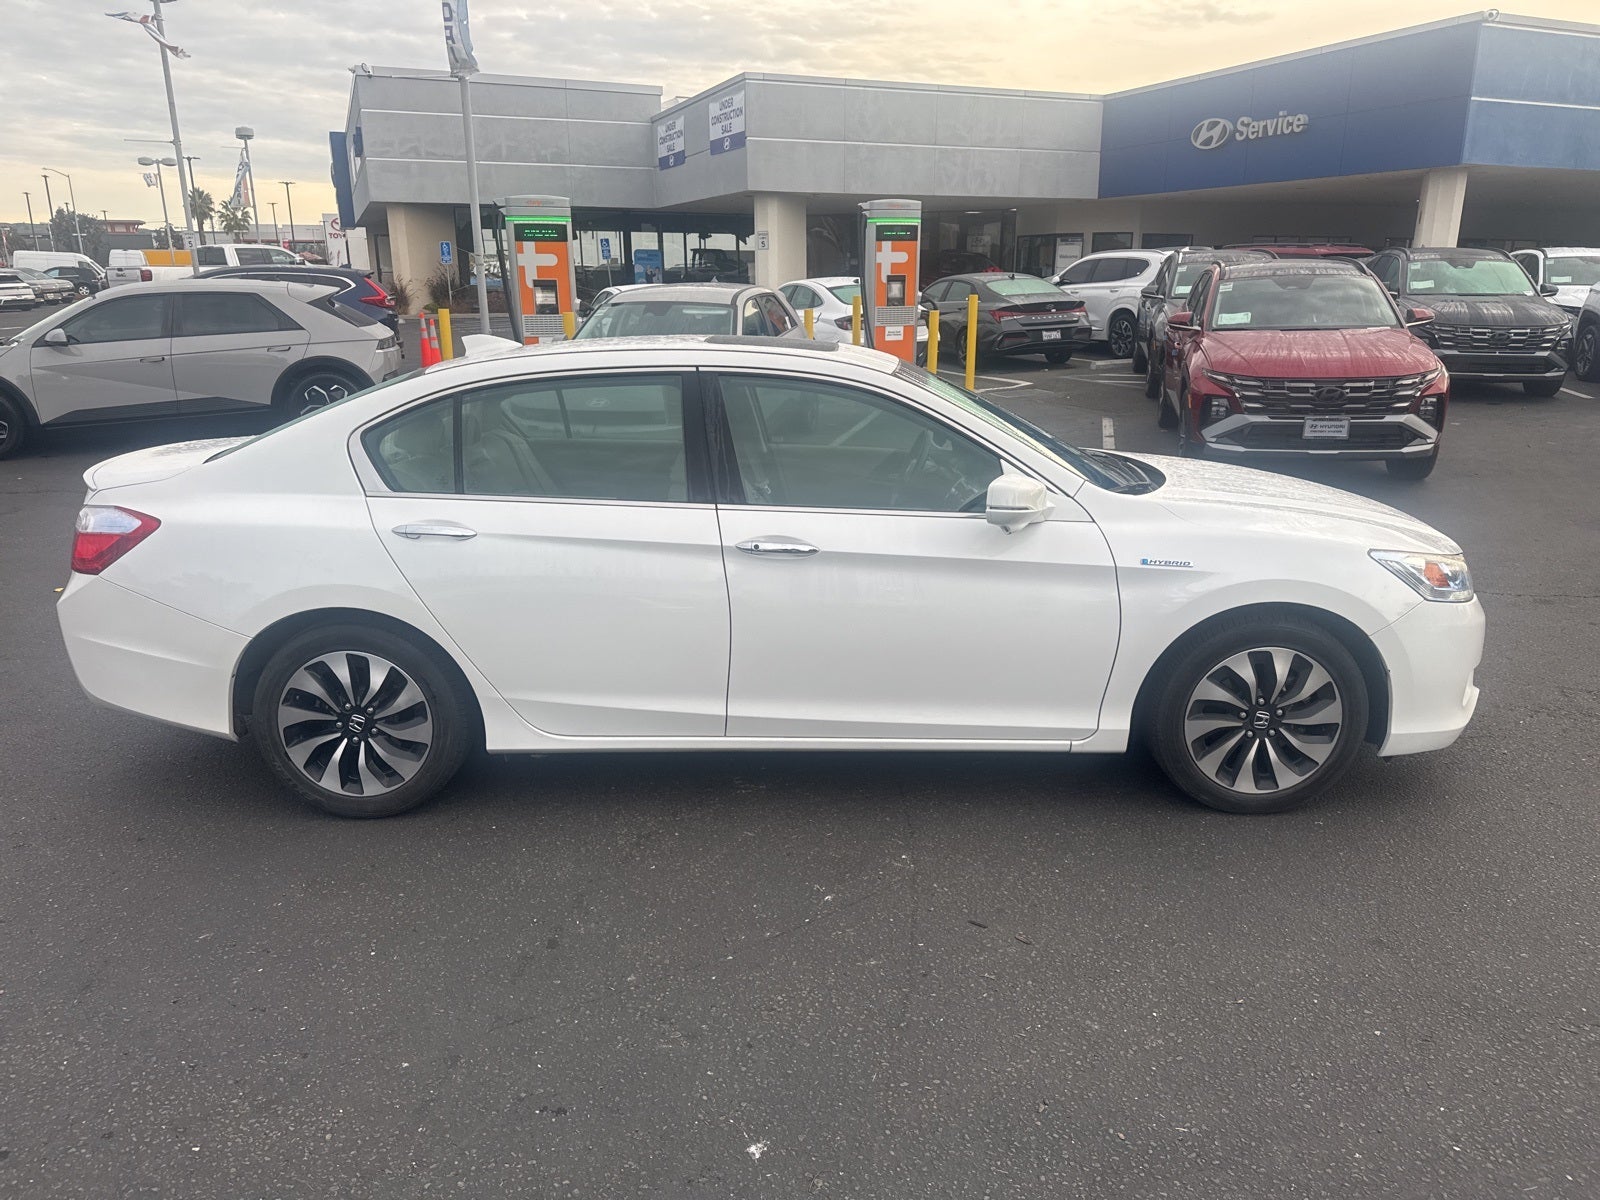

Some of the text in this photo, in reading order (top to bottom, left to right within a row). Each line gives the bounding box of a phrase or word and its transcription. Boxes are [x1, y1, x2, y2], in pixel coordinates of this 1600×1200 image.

[719, 97, 734, 111] UNDER
[711, 106, 744, 126] CONSTRUCTION
[665, 121, 676, 133] UNDER
[721, 123, 732, 135] SALE
[1235, 110, 1309, 141] Service
[659, 129, 684, 145] CONSTRUCTION
[666, 142, 676, 153] SALE
[188, 240, 194, 248] 5
[1149, 559, 1192, 567] HYBRID
